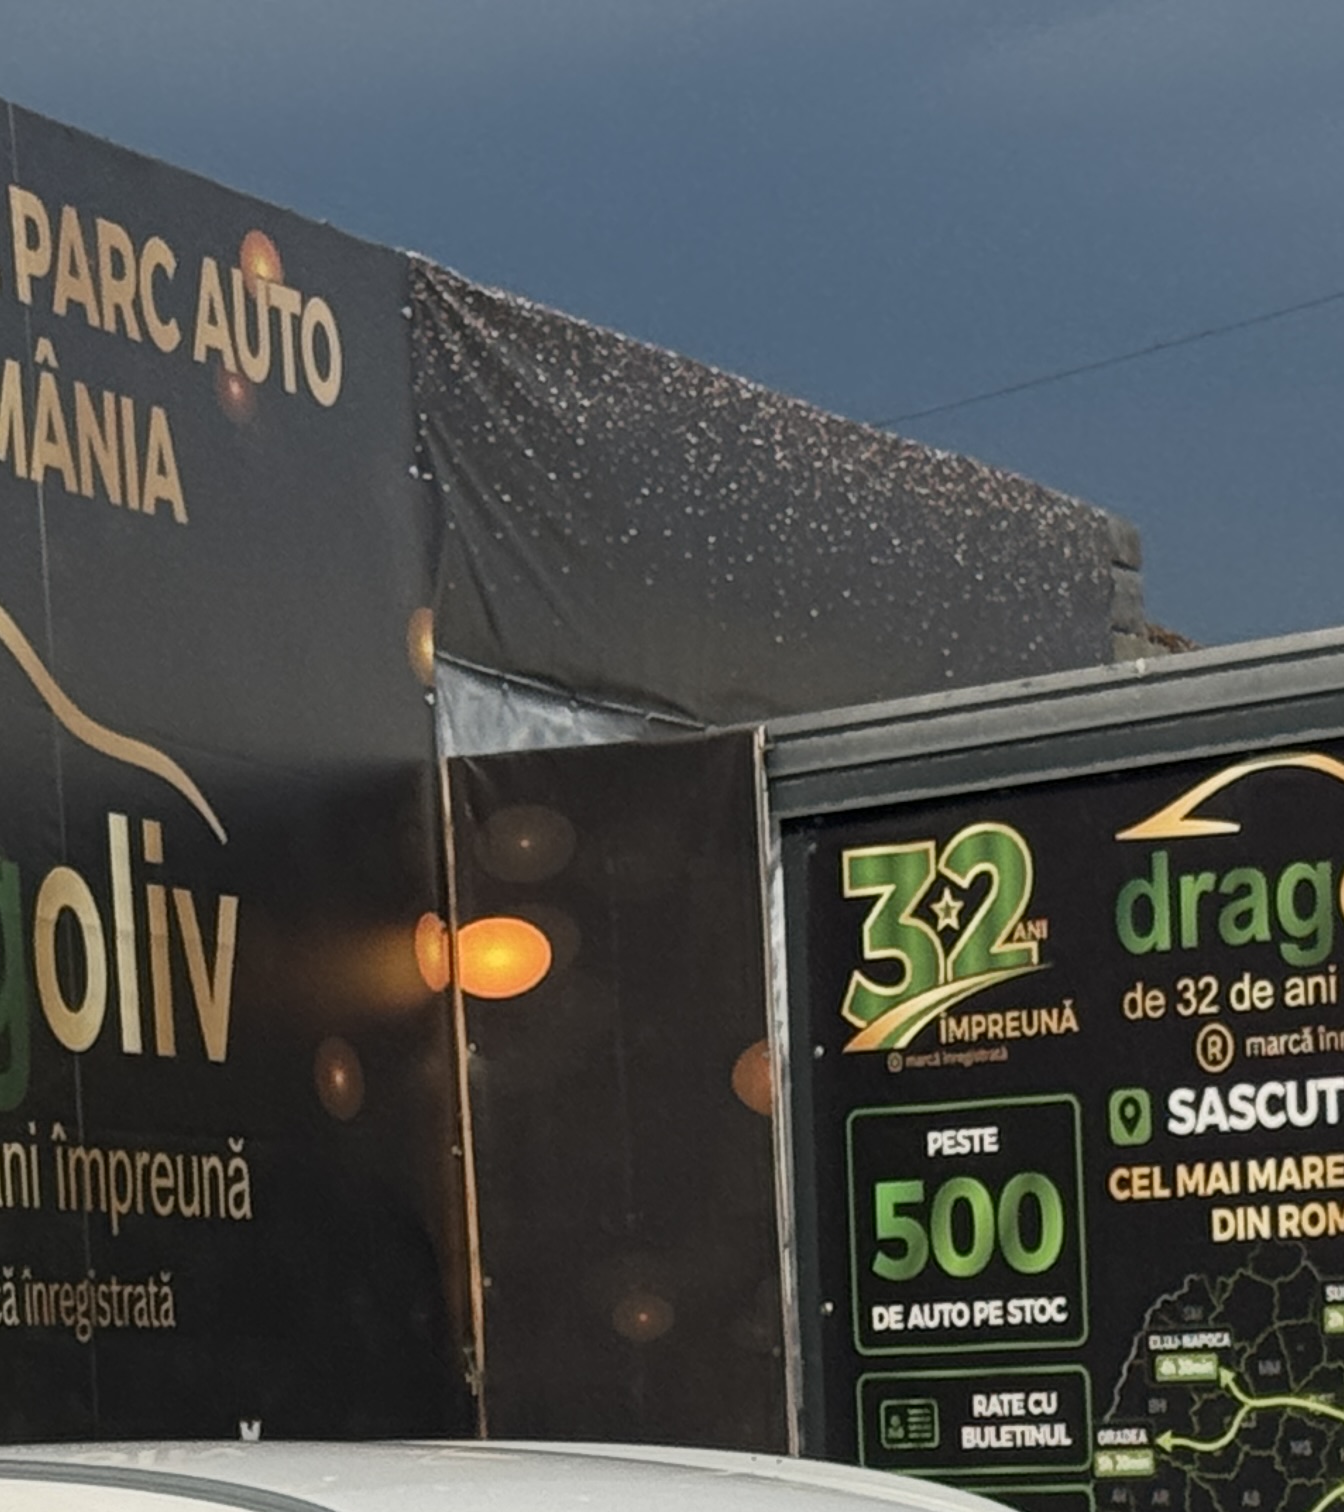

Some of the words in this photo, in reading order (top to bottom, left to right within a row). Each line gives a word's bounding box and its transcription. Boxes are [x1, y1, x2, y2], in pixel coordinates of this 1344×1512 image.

[10, 184, 182, 354] PARC
[193, 254, 343, 407] AUTO
[841, 822, 1039, 1030] 32
[1012, 919, 1049, 942] ANI
[1122, 982, 1166, 1019] de
[1175, 976, 1222, 1018] 32
[1230, 972, 1275, 1012] de
[1284, 965, 1338, 1007] ani
[939, 999, 1080, 1045] ÎMPREUNĂ
[1245, 1026, 1314, 1057] marcă
[926, 1127, 1000, 1157] PESTE
[50, 1122, 254, 1236] împreună
[1108, 1166, 1172, 1201] CEL
[1176, 1160, 1240, 1197] MAI
[872, 1171, 1065, 1282] 500
[1210, 1205, 1272, 1243] DIN
[21, 1265, 177, 1343] înregistrată
[871, 1305, 905, 1331] DE
[907, 1303, 970, 1329] AUTO
[973, 1300, 1005, 1326] PE
[1007, 1297, 1069, 1324] STOC
[972, 1393, 1026, 1418] RATE
[1027, 1391, 1058, 1416] CU
[960, 1423, 1073, 1450] BULETINUL
